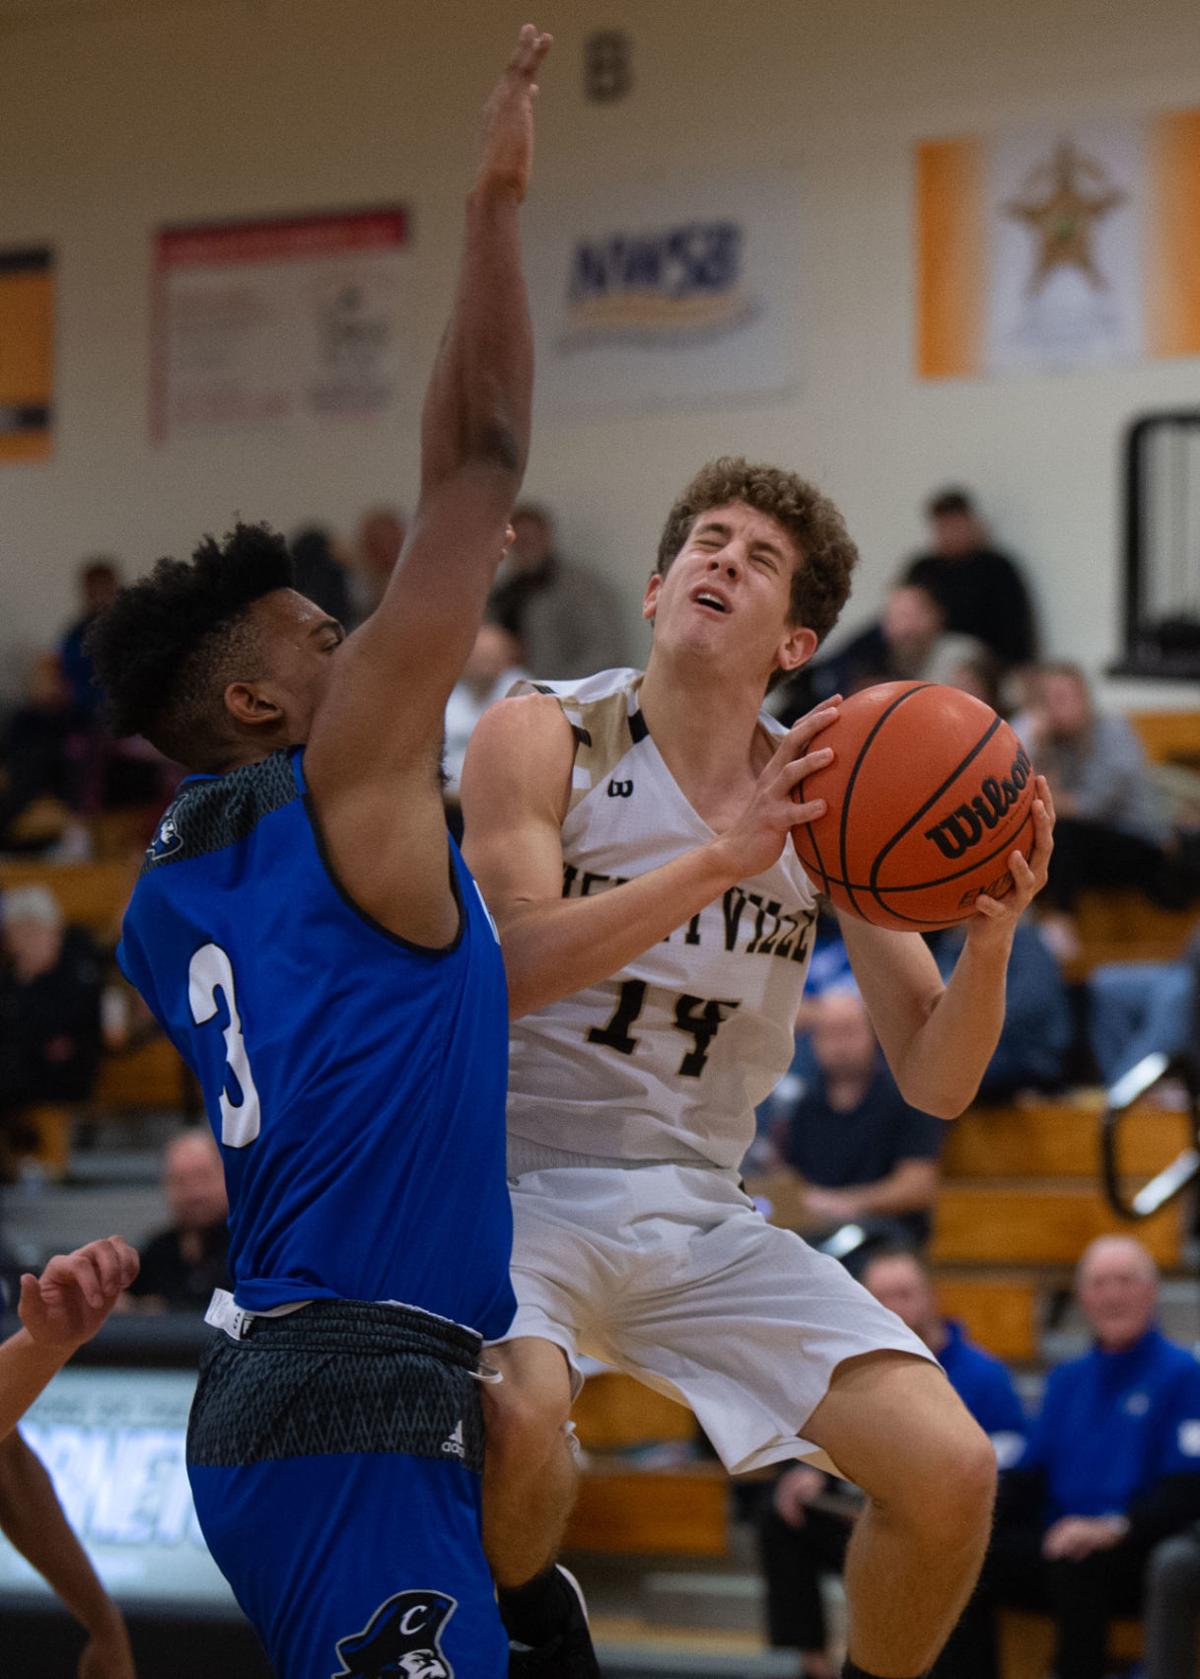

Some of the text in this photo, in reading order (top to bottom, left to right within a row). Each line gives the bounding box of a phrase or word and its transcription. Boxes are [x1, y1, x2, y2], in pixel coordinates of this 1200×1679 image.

[924, 745, 1032, 859] Wilson
[188, 942, 261, 1148] 3
[586, 979, 739, 1077] 14
[399, 1604, 428, 1635] C
